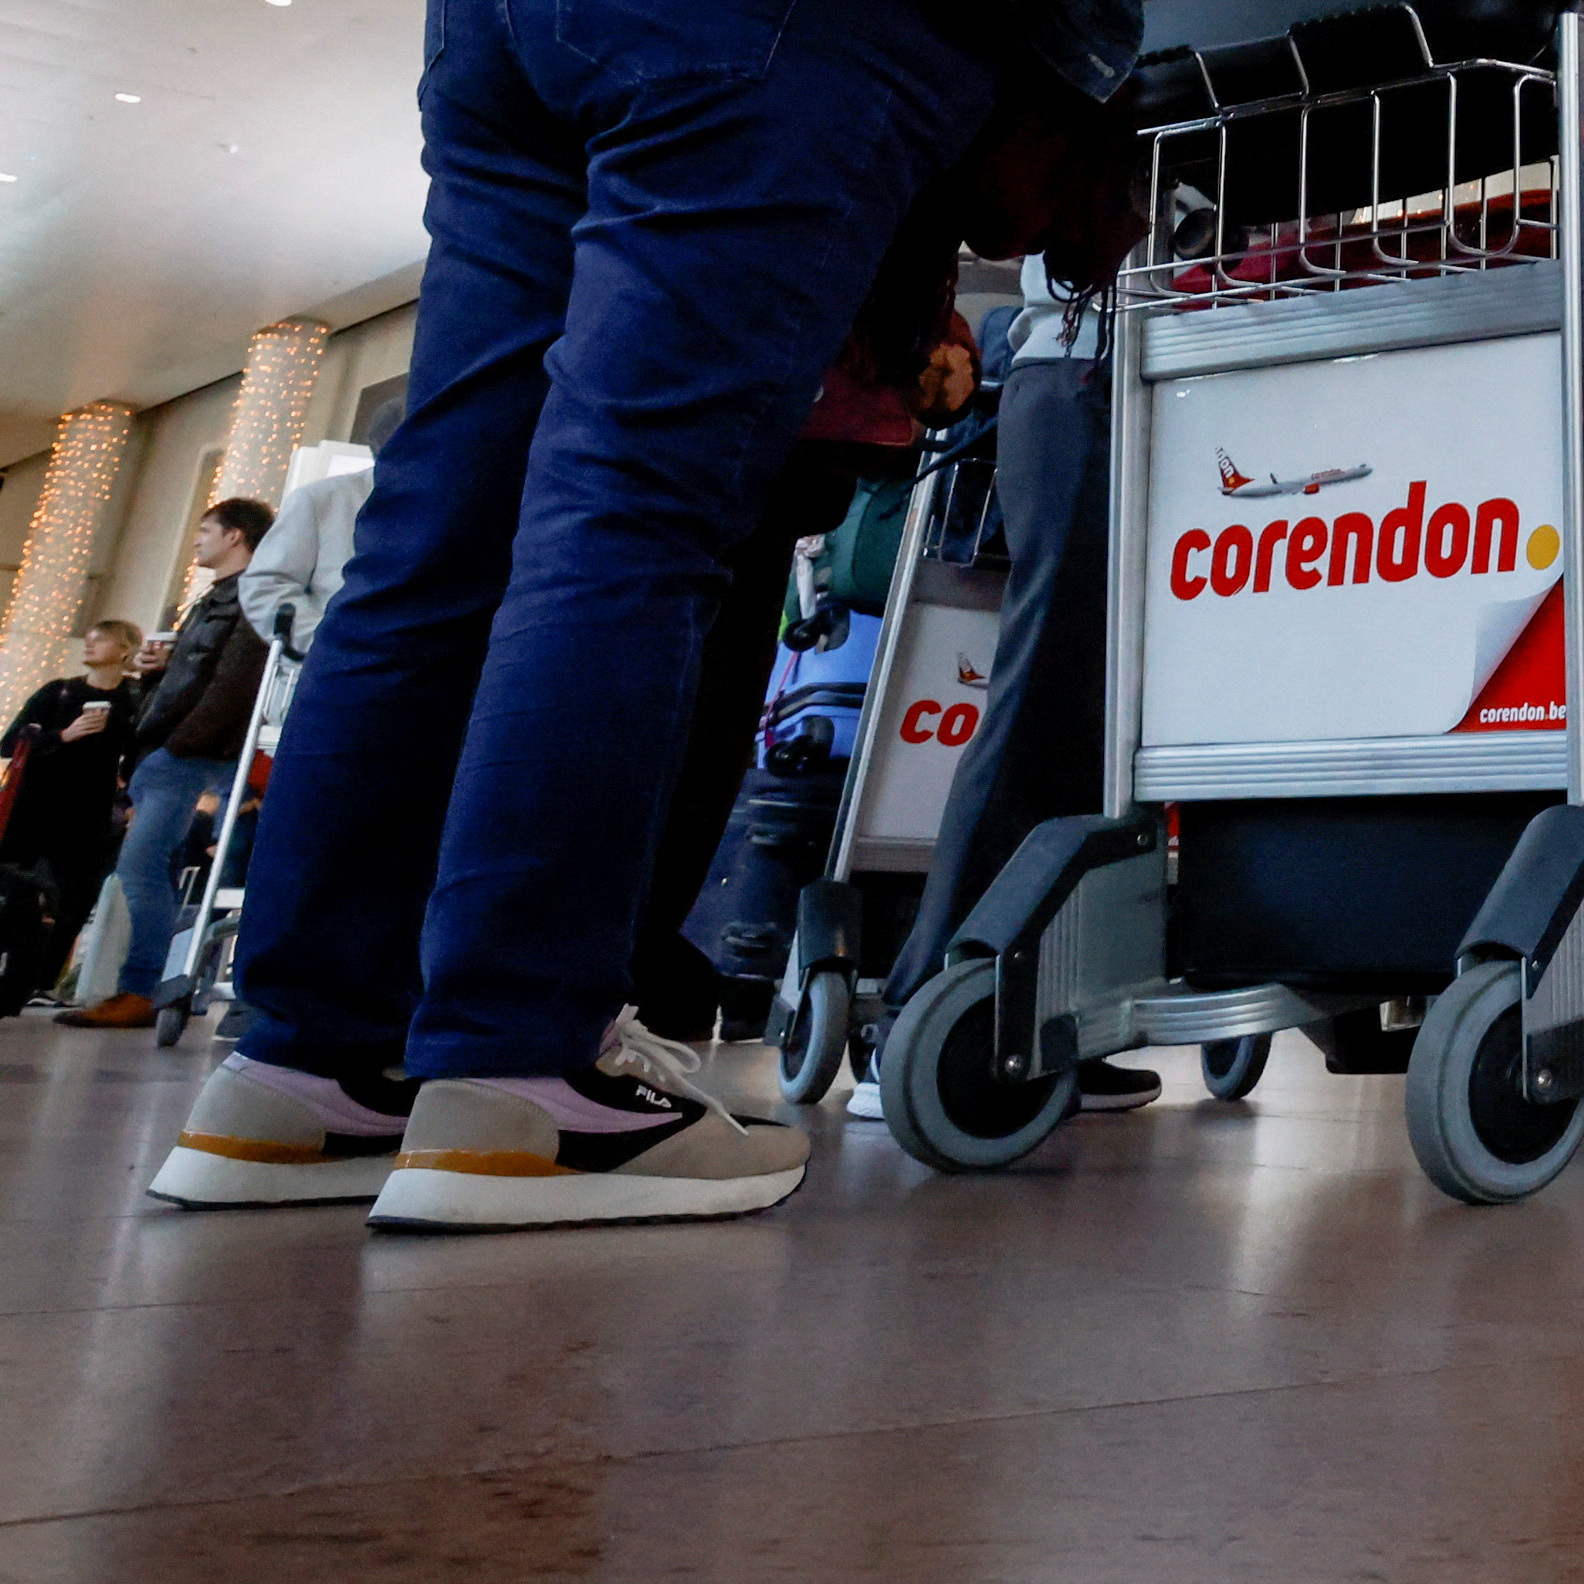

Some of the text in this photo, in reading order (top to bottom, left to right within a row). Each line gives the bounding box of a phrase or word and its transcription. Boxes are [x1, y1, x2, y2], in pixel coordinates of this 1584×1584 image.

[1169, 479, 1520, 601] corendon
[1479, 701, 1567, 724] corendon.be
[635, 1084, 672, 1109] FILA
